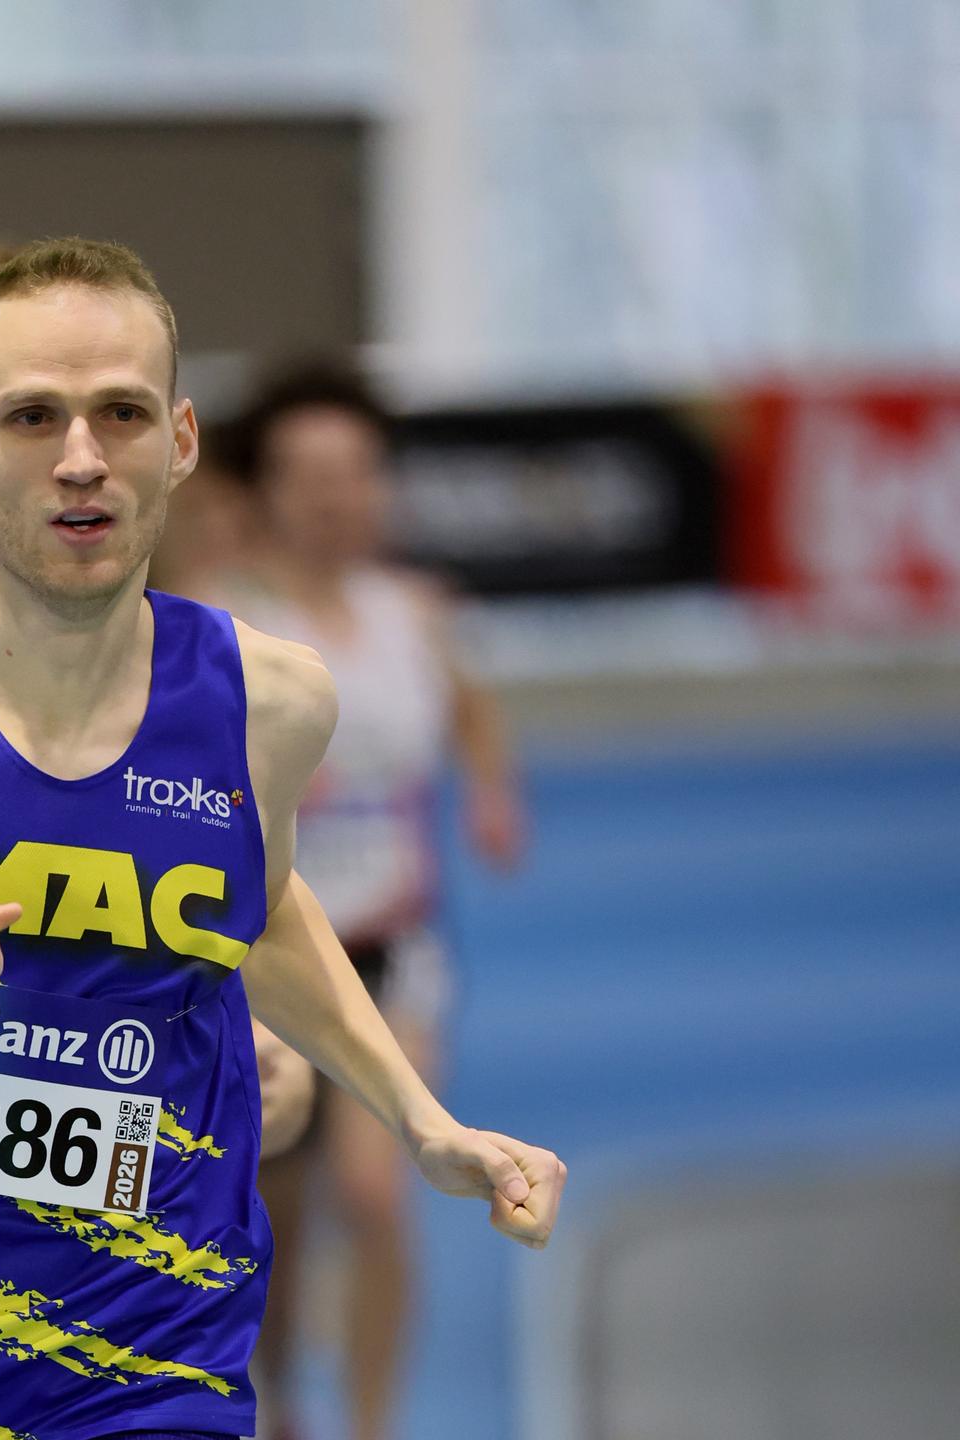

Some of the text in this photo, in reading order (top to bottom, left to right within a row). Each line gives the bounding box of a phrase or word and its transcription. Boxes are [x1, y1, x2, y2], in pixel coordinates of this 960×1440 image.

[123, 766, 231, 818] trakks
[125, 803, 231, 830] running trail outdoor
[112, 1149, 139, 1209] 2026
